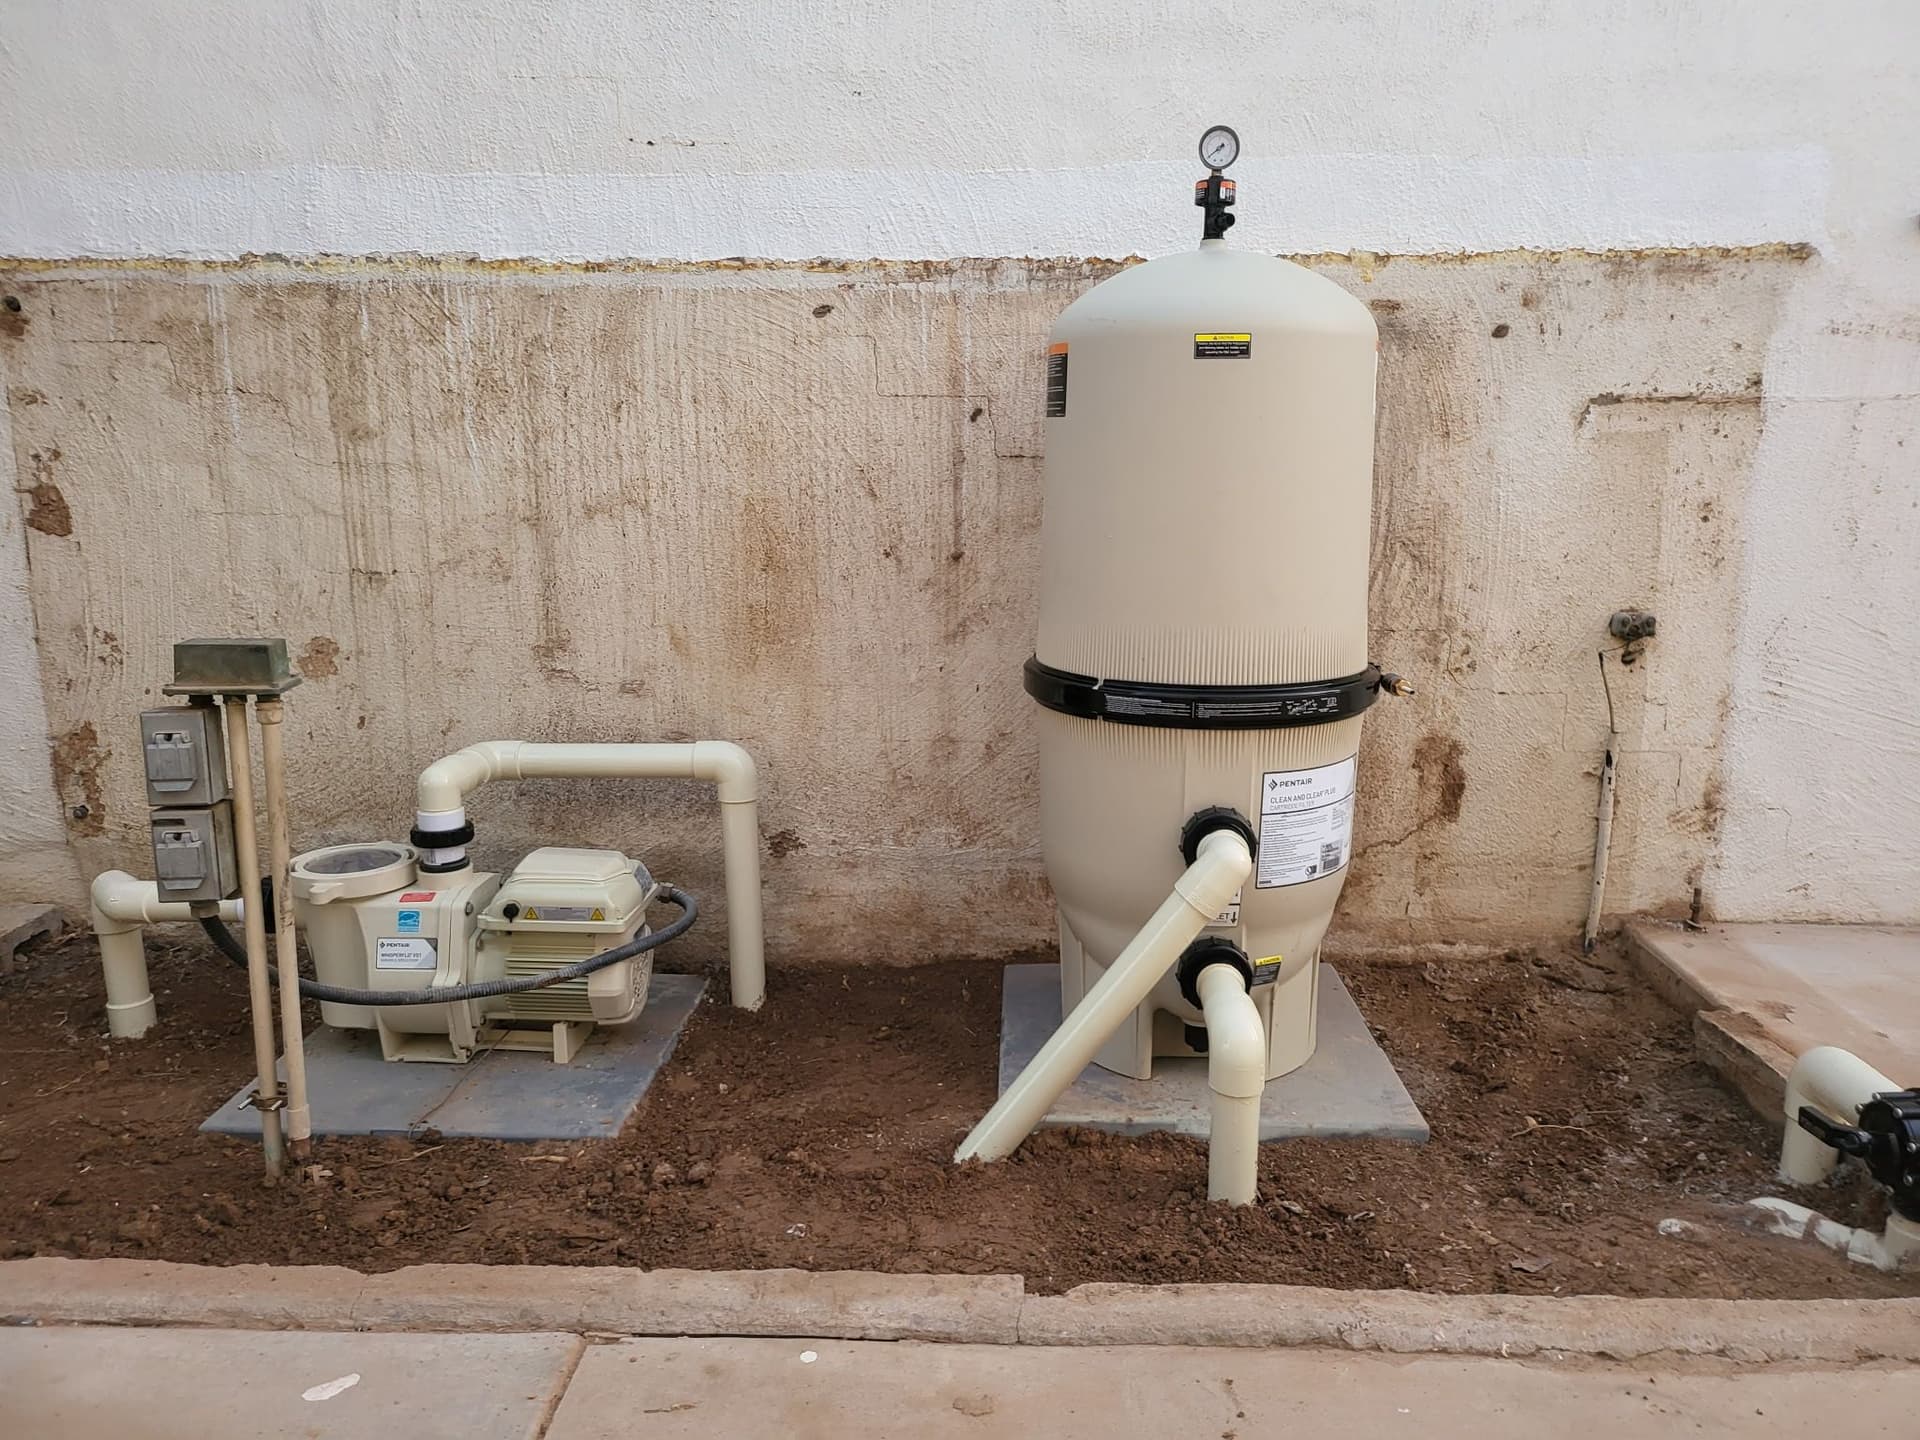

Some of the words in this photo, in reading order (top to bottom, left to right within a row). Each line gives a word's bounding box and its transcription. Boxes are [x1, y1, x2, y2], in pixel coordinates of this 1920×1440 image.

[1280, 778, 1312, 788] PENTAIR
[1270, 795, 1292, 804] CLEAN
[1293, 793, 1305, 802] AND
